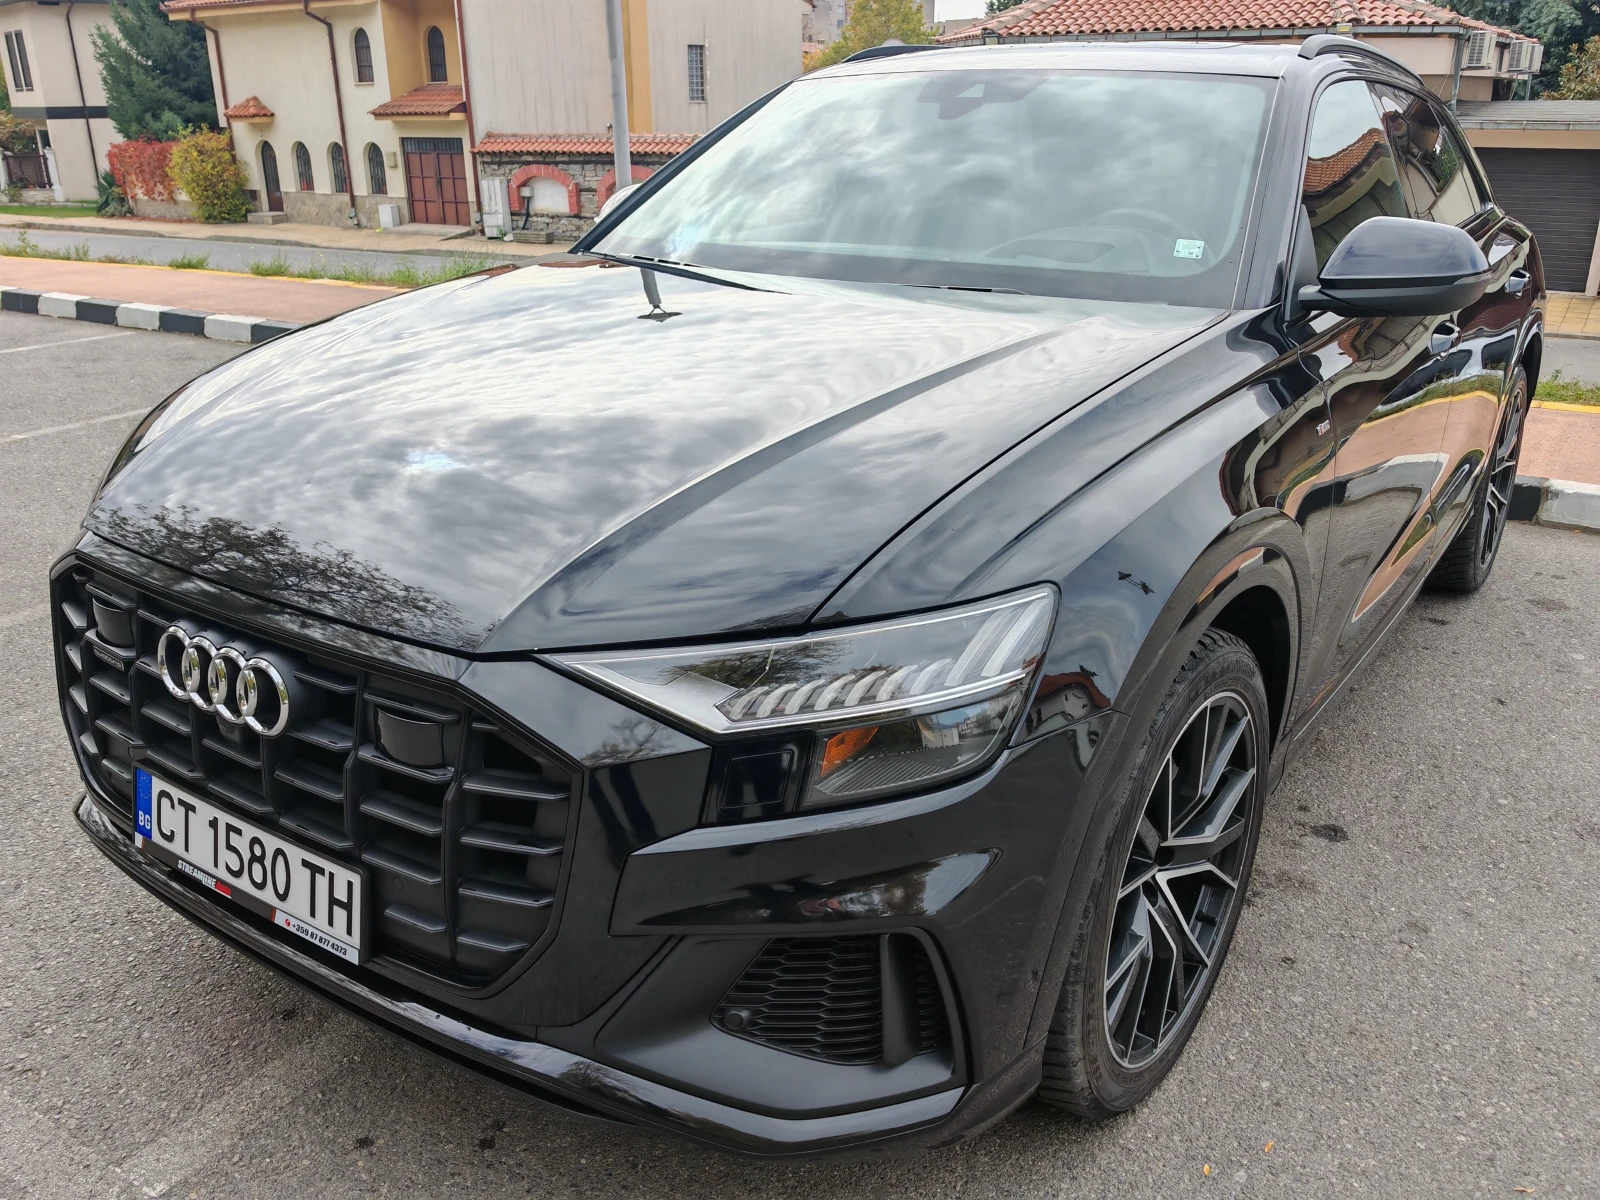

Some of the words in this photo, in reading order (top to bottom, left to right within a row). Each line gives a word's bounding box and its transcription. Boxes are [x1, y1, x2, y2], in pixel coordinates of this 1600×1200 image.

[138, 810, 151, 830] BG
[156, 789, 197, 853] CT
[208, 816, 291, 902] 1580
[301, 858, 354, 938] TH
[177, 859, 217, 888] STREAMLINE
[292, 923, 309, 937] +359
[309, 931, 318, 941] 87
[318, 935, 331, 947] 877
[330, 942, 348, 956] 4373
